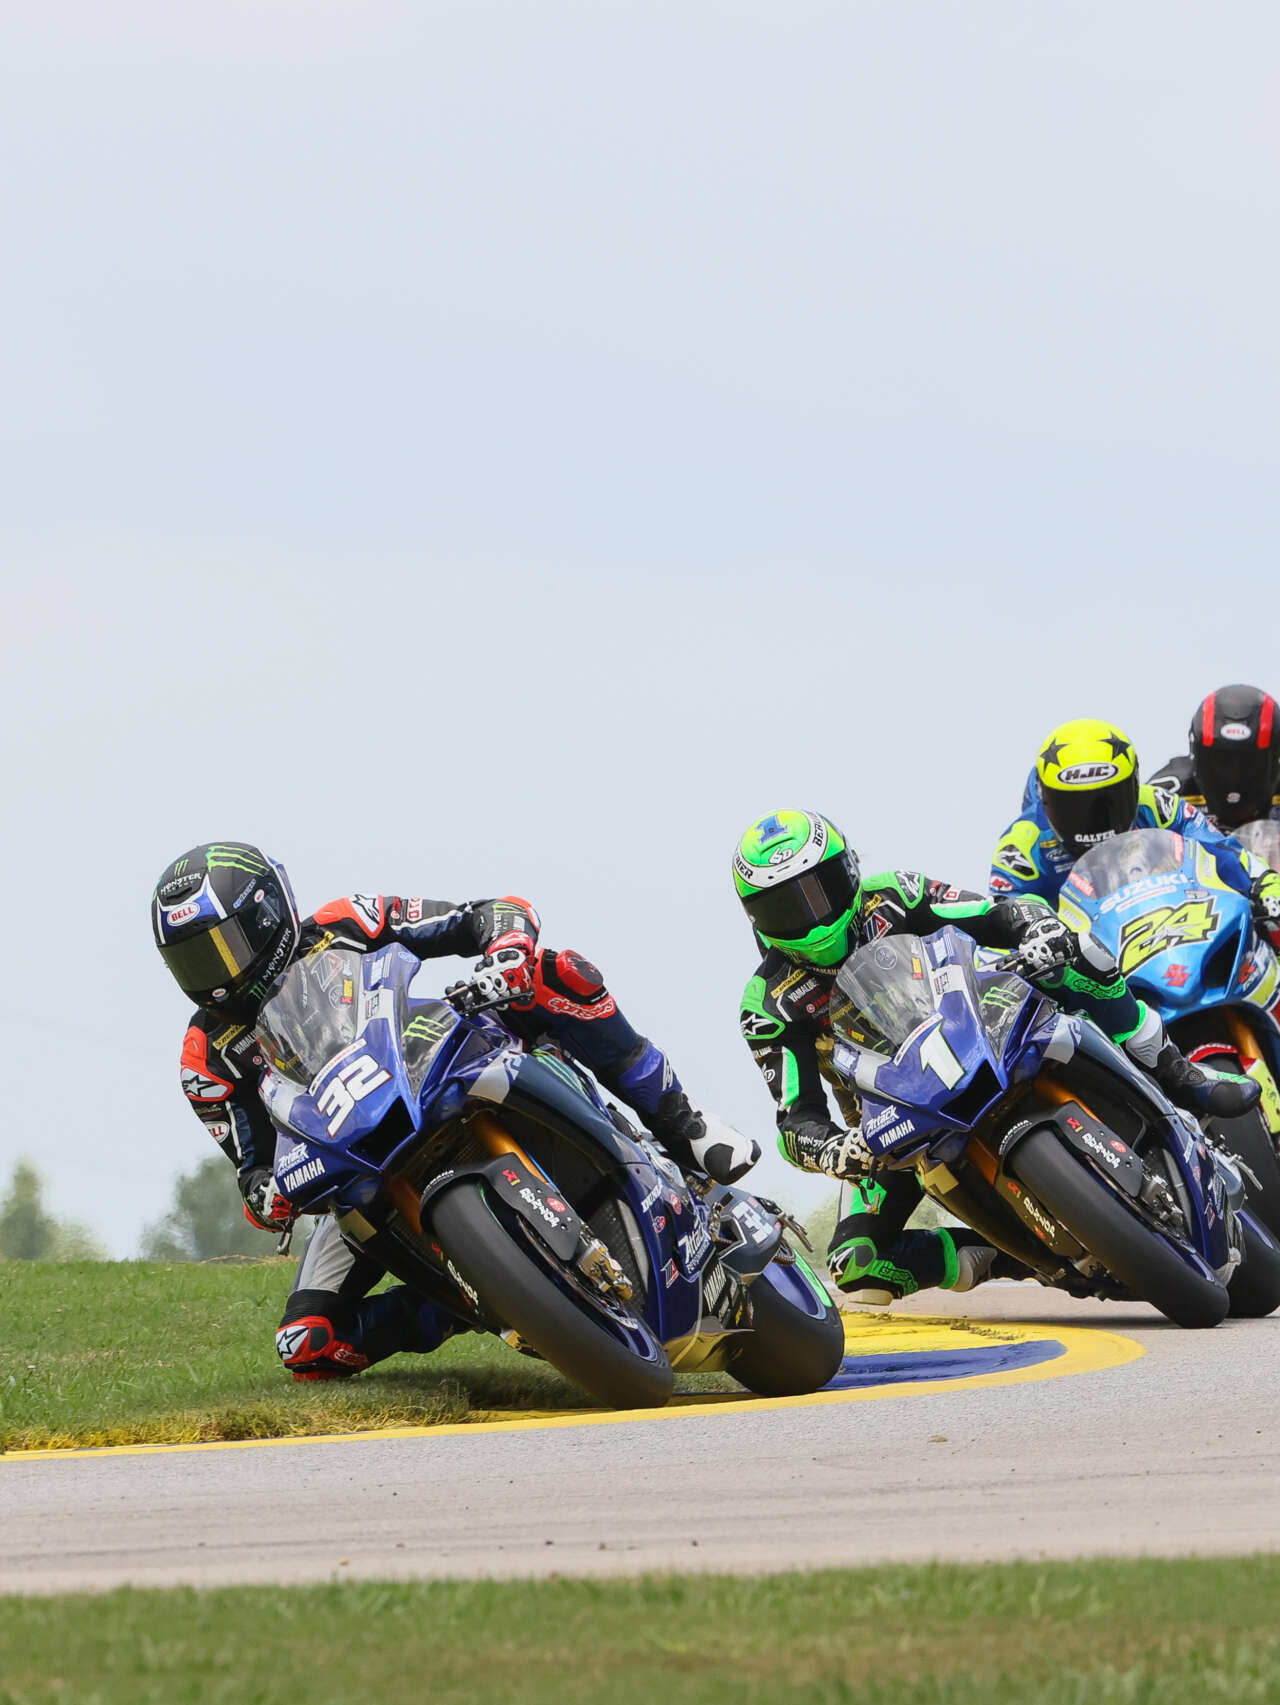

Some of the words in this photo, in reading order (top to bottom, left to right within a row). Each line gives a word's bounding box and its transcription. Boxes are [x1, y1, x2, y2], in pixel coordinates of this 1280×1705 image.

[1065, 764, 1110, 781] HJC
[1074, 830, 1117, 843] GALFER
[160, 872, 203, 895] MONSTER
[1100, 874, 1188, 915] SUZUKI
[171, 906, 195, 923] BELL
[1119, 891, 1219, 976] 24
[262, 927, 292, 981] MONSTER
[919, 1023, 967, 1091] 1
[316, 1053, 393, 1140] 32
[878, 1119, 916, 1148] YAMAHA
[283, 1157, 326, 1193] YAMAHA
[703, 1261, 728, 1313] YAMAHA
